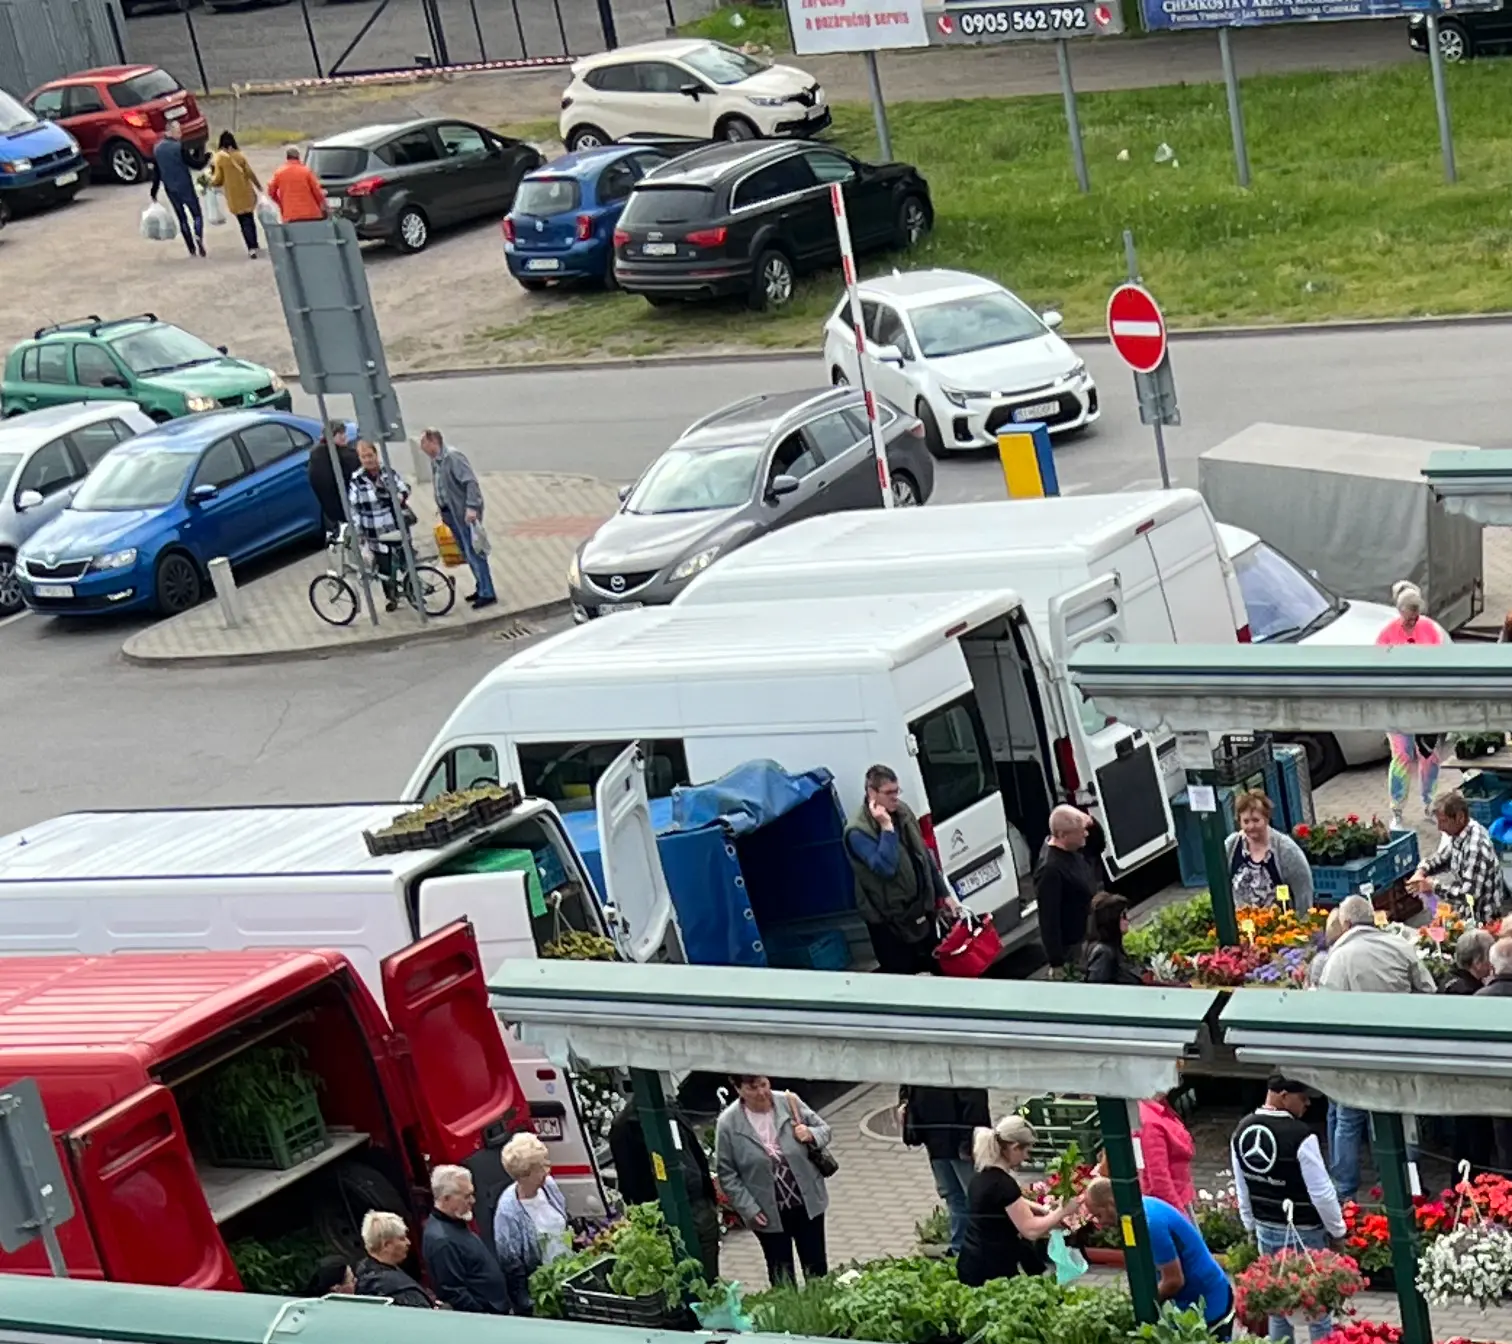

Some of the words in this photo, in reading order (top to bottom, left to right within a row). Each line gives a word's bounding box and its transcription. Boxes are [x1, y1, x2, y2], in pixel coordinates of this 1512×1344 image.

[962, 12, 1008, 34] 0905
[1013, 10, 1048, 30] 562
[1050, 8, 1087, 28] 792
